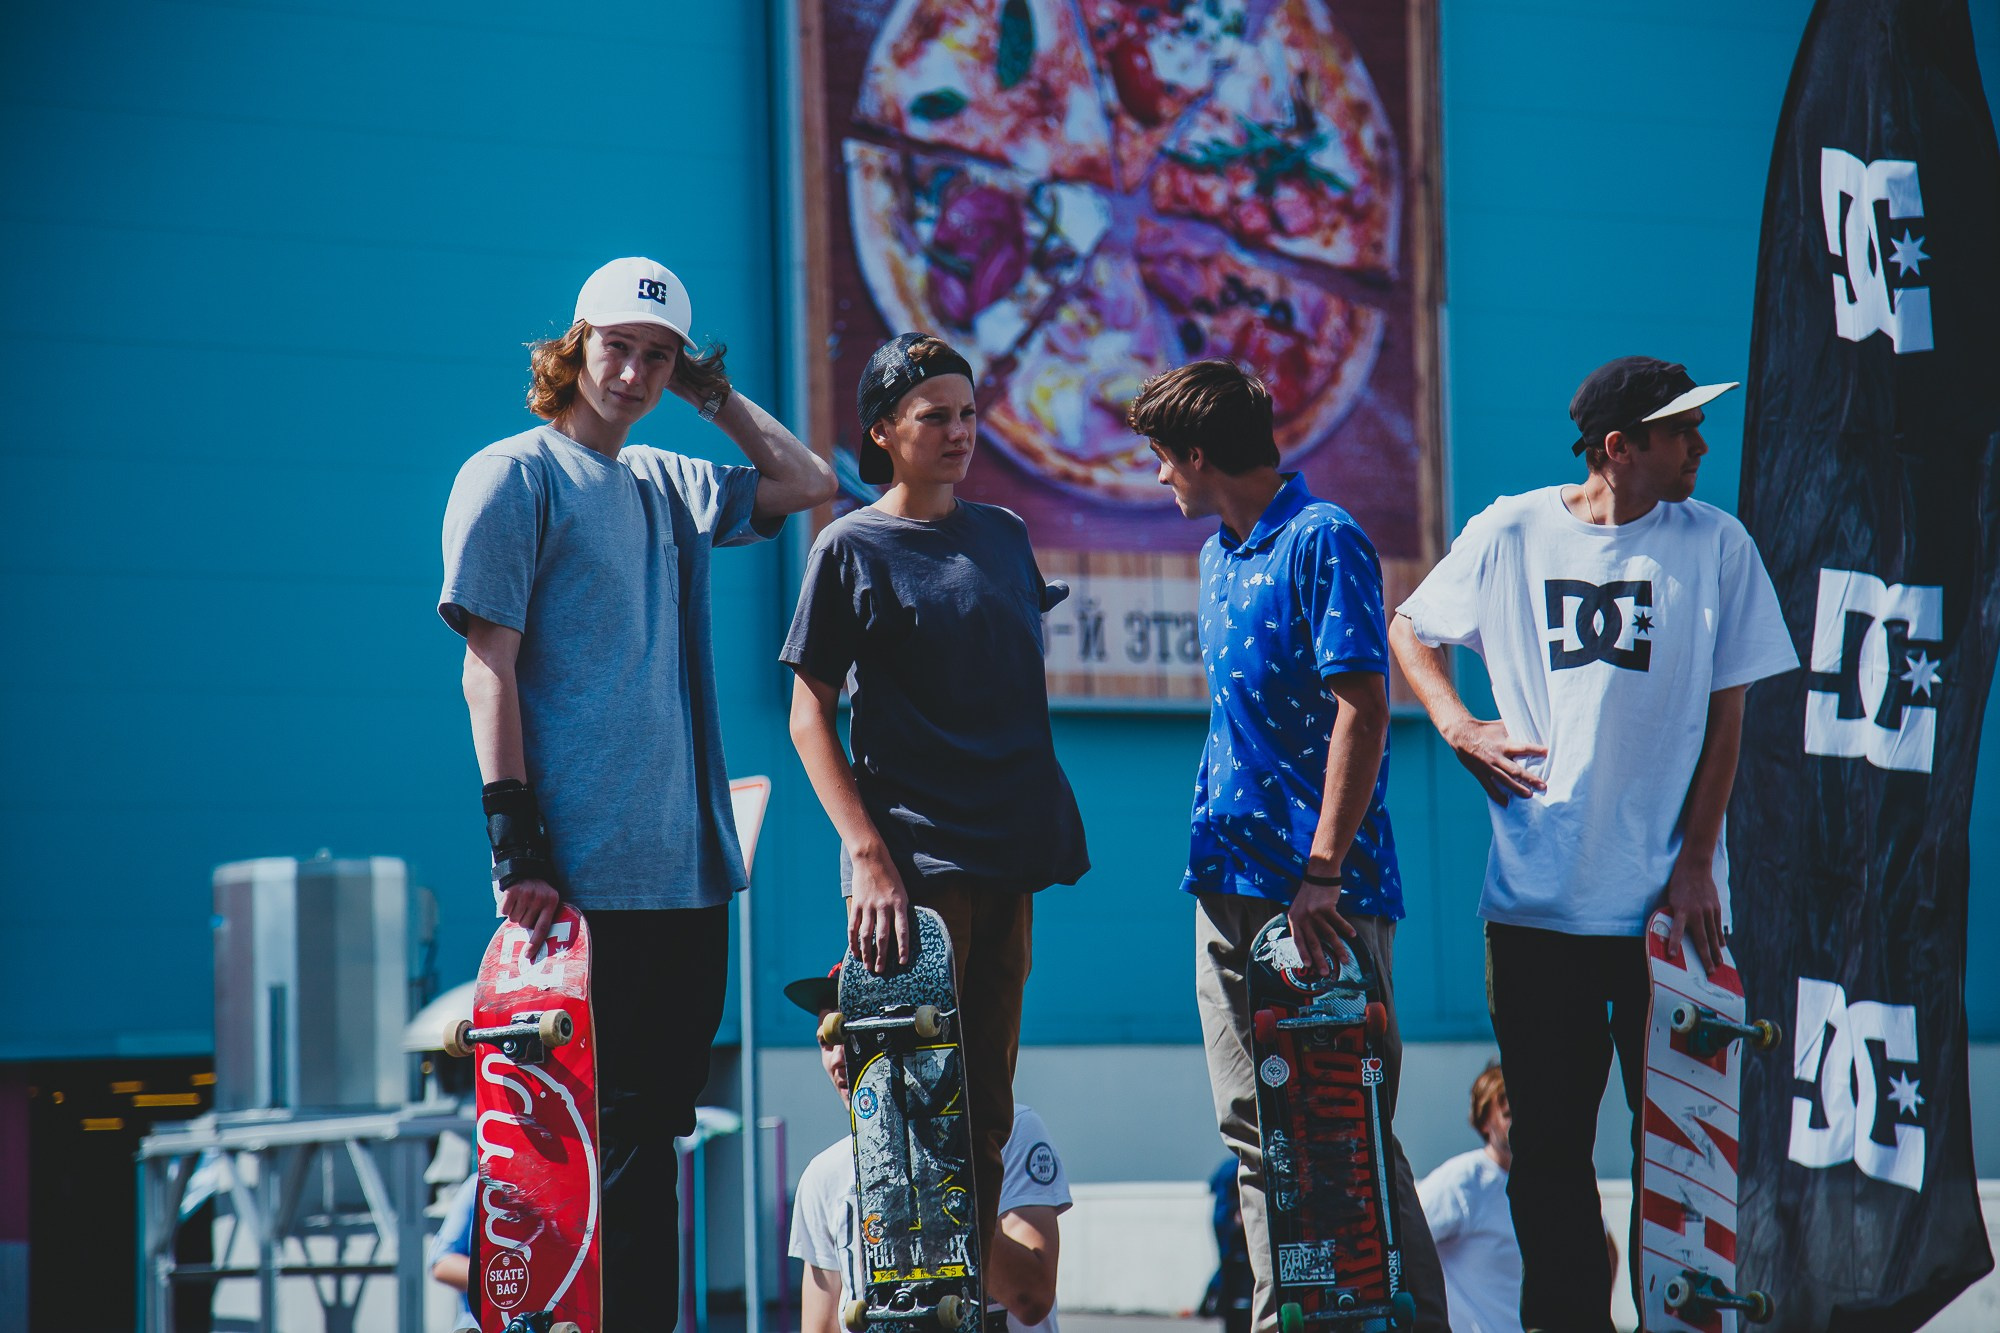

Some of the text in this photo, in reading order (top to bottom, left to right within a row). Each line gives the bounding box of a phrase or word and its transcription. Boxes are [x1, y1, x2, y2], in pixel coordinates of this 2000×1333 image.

[1820, 147, 1934, 354] DC
[638, 279, 667, 305] DC
[1124, 611, 1200, 664] эта
[1545, 578, 1653, 672] DC
[1805, 568, 1943, 774] DC
[1364, 1071, 1382, 1082] SB
[1788, 977, 1925, 1193] DC
[489, 1268, 525, 1282] SKATE
[496, 1283, 518, 1296] BAG
